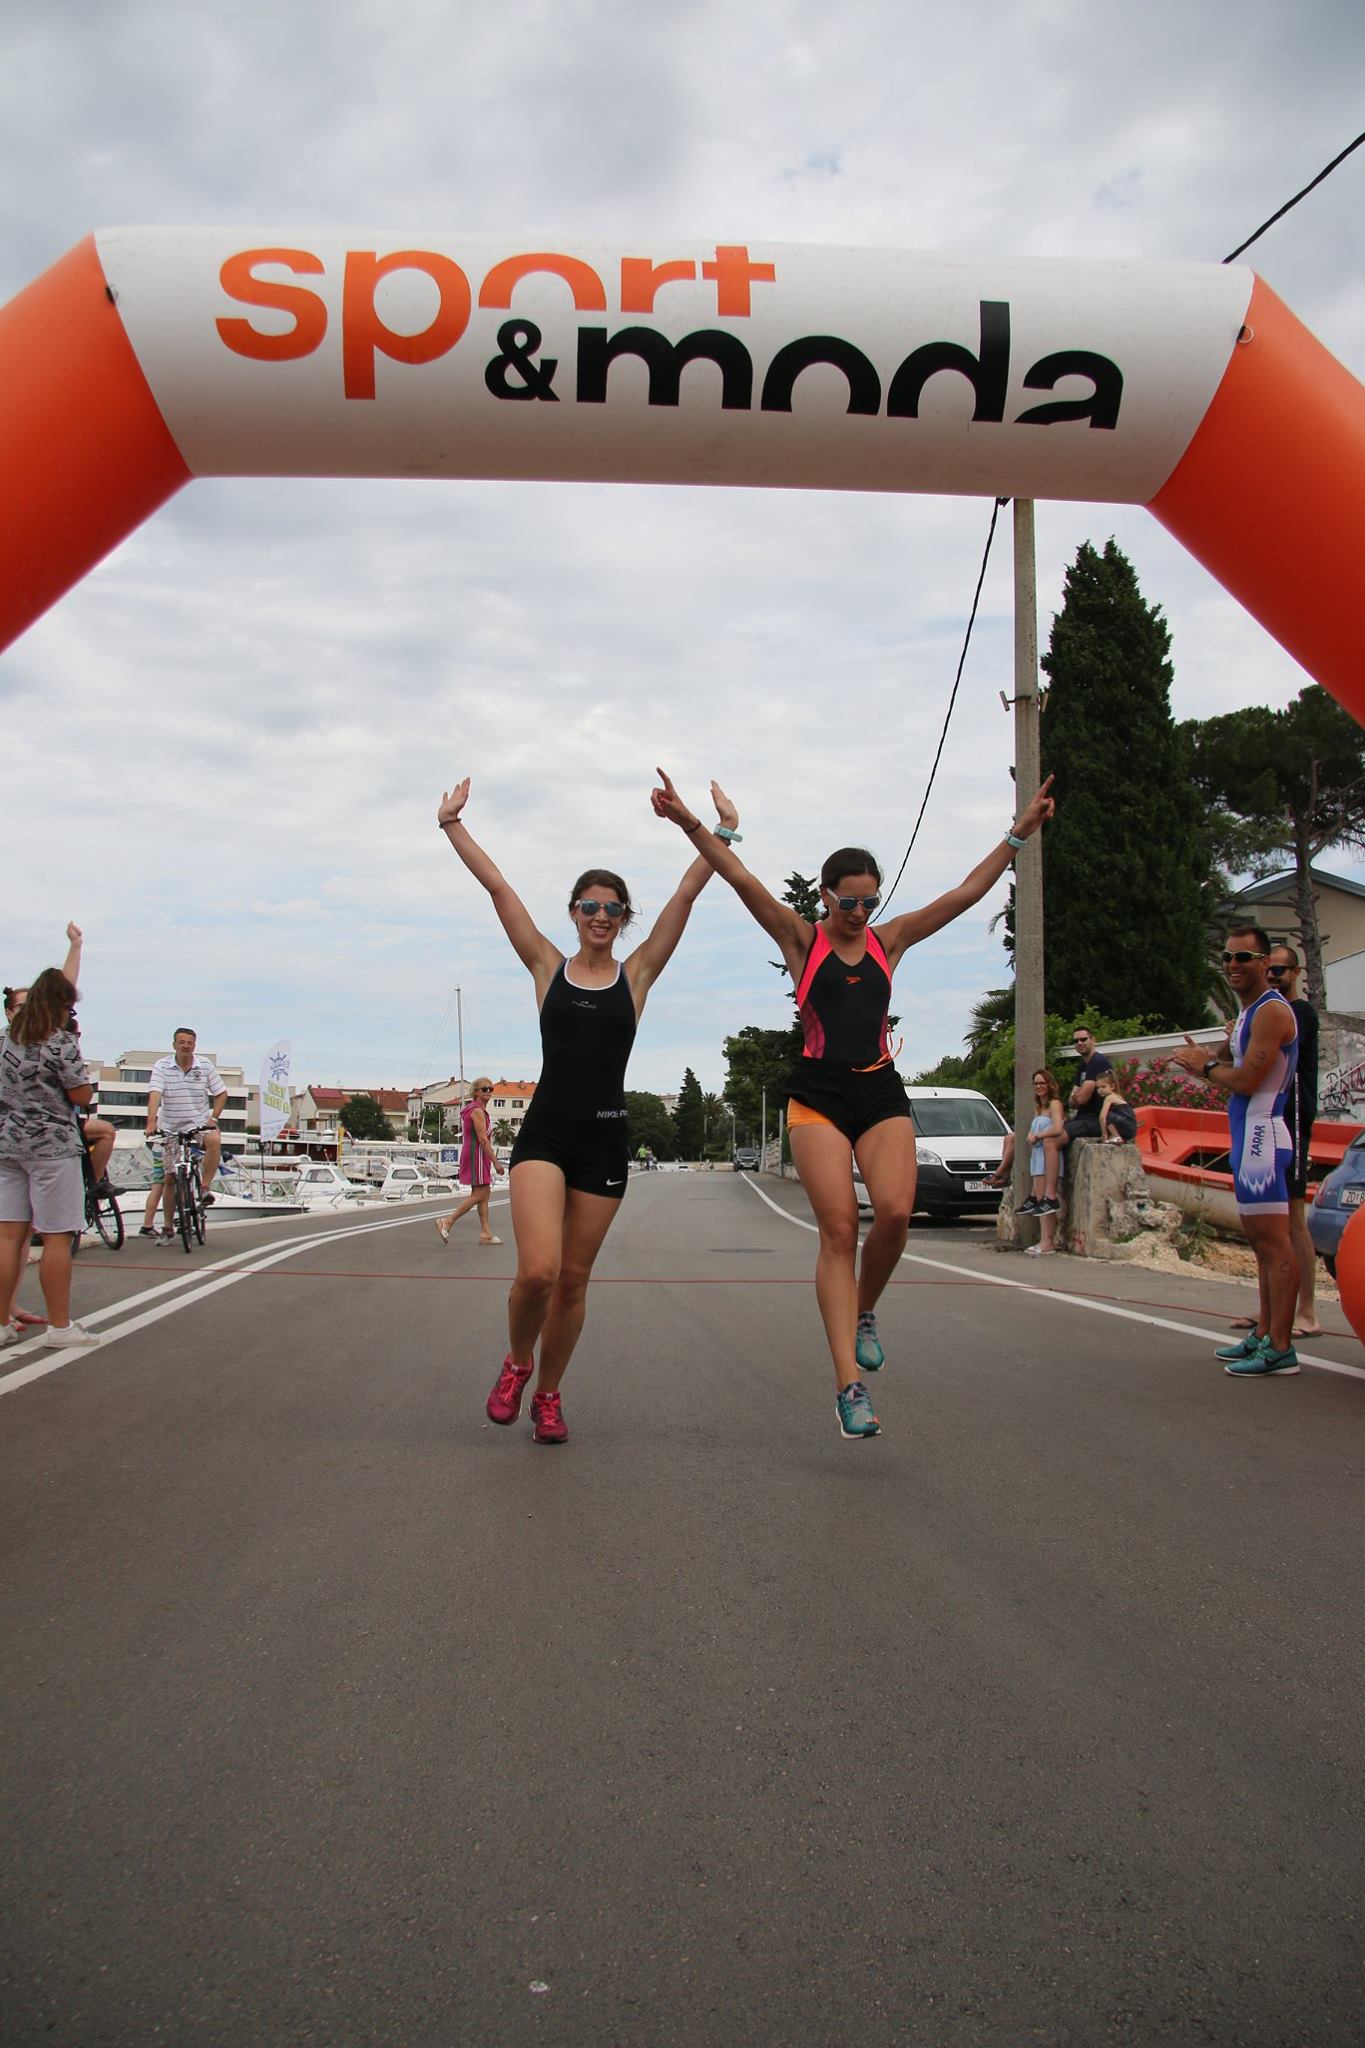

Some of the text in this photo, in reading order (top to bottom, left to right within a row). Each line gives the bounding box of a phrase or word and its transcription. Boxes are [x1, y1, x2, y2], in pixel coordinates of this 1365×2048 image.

[215, 246, 776, 400] sport
[595, 1110, 618, 1119] NIKE
[1250, 1125, 1265, 1157] ZADAR
[1345, 1191, 1356, 1203] ZD
